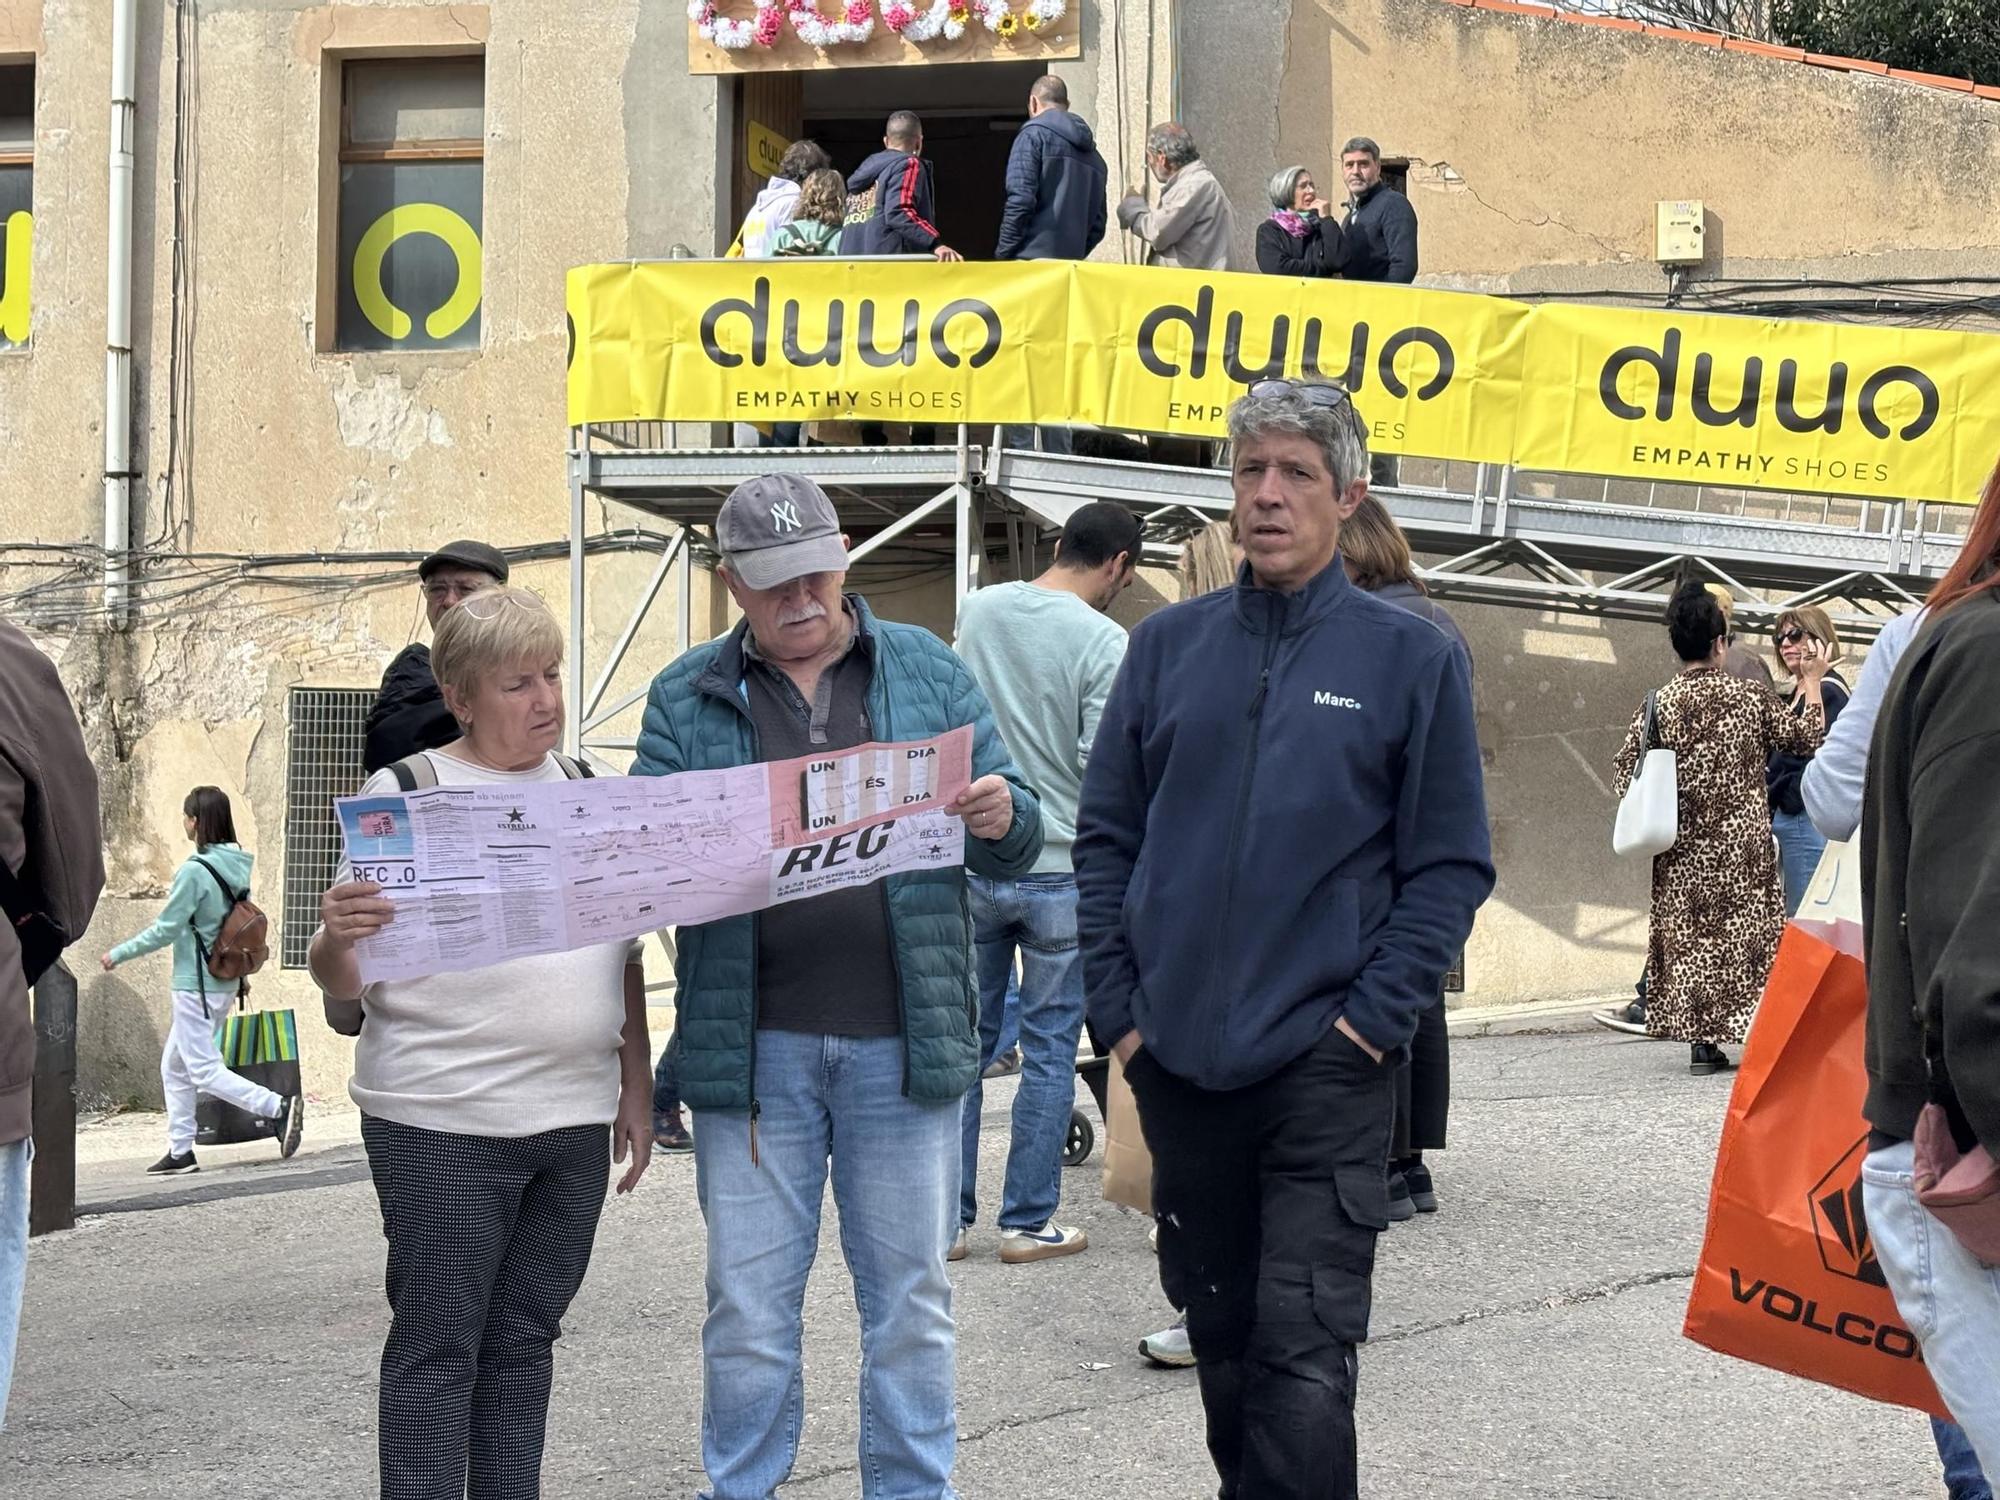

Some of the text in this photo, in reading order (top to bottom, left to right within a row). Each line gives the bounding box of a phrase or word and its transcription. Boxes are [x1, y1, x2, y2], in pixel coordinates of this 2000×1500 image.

[700, 276, 1002, 369] duuo
[1137, 285, 1454, 401] duuo
[1599, 327, 1940, 441] duuo
[736, 391, 963, 409] EMPATHY SHOES
[1633, 446, 1888, 481] EMPATHY SHOES
[770, 500, 802, 532] NY
[907, 747, 937, 759] DIA
[811, 761, 836, 773] UN
[865, 776, 886, 789] ÉS
[902, 792, 932, 804] DIA
[812, 815, 837, 828] UN
[777, 819, 896, 878] REC
[352, 866, 388, 883] REC
[1729, 1267, 1925, 1363] VOLCO
